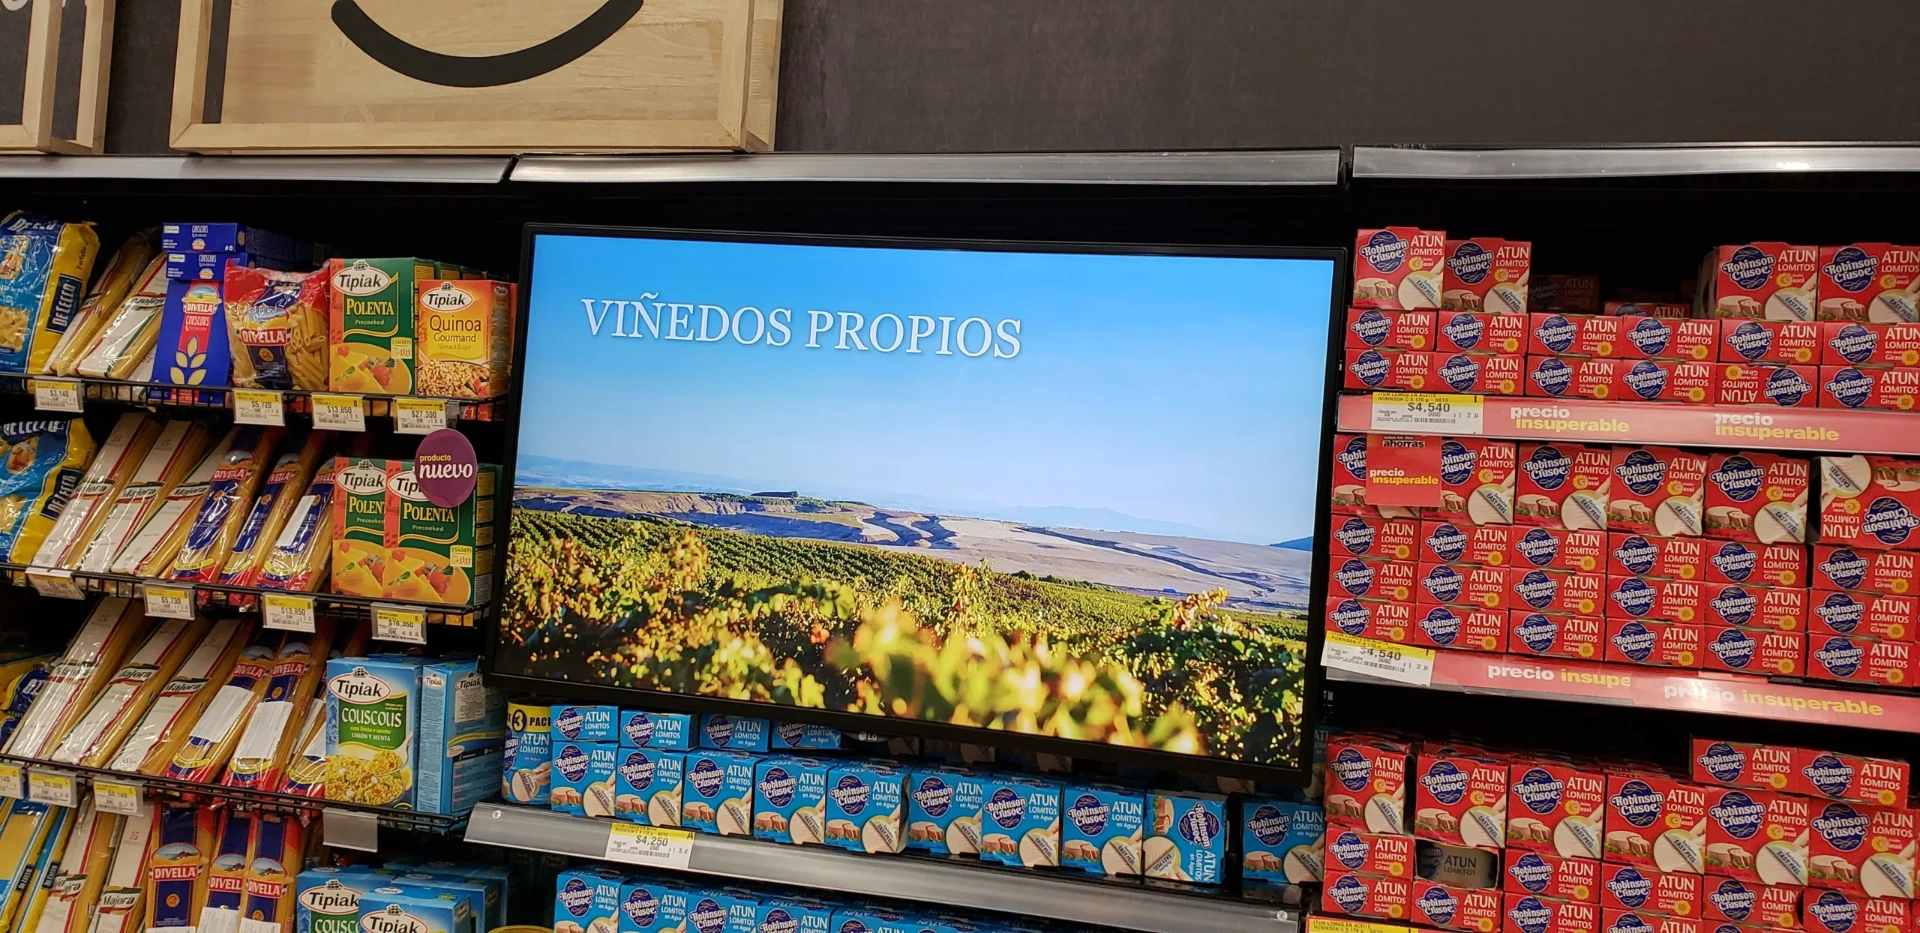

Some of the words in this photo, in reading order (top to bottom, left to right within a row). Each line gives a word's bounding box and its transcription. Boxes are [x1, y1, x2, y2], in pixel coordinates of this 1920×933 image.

[1361, 239, 1408, 255] Robinson
[1410, 235, 1444, 248] ATUN
[76, 246, 86, 269] Farfalle
[1369, 250, 1406, 265] Crusoe
[1410, 248, 1443, 256] LOMITOS
[1778, 250, 1816, 262] ATUN
[1723, 255, 1775, 273] Robinson
[1777, 264, 1815, 272] LOMITOS
[1732, 266, 1772, 281] Crusoe
[339, 274, 382, 291] Tipiak
[428, 294, 466, 306] Tipiak
[186, 303, 214, 313] DIVELLA
[346, 299, 394, 316] POLENTA
[186, 315, 210, 326] COUSCOUS
[430, 315, 481, 332] Quinoa
[581, 291, 792, 347] VIÑEDOS
[805, 309, 1022, 359] PROPIOS
[1351, 317, 1391, 331] Robinson
[1397, 313, 1430, 326] ATUN
[241, 329, 286, 344] DIVELLA
[1359, 326, 1390, 337] Crusoe
[1397, 326, 1428, 334] LOMITOS
[434, 333, 476, 342] Gourmand
[1532, 365, 1573, 381] Robinson
[1579, 362, 1613, 375] ATUN
[1539, 374, 1570, 387] Crusoe
[1579, 374, 1613, 384] LOMITOS
[1768, 377, 1801, 388] Crusoe
[1721, 389, 1758, 402] ATUN
[1765, 384, 1811, 396] Robinson
[1408, 402, 1450, 413] $4,540
[1510, 405, 1570, 420] precio
[1516, 418, 1630, 432] insuperable
[1716, 425, 1839, 440] insuperable
[419, 454, 451, 462] producto
[214, 469, 245, 479] DIVELLA
[419, 463, 473, 480] nuevo
[1370, 468, 1404, 477] precio
[1768, 462, 1807, 476] ATUN
[268, 472, 291, 482] IVELLA
[344, 473, 384, 489] Tipiak
[1373, 476, 1439, 485] insuperable
[1711, 467, 1765, 485] Robinson
[1768, 477, 1806, 486] LOMITOS
[1720, 478, 1762, 490] Crusoe
[349, 497, 385, 514] POLEN
[403, 503, 455, 523] POLENTA
[1866, 507, 1908, 522] Crusoe
[1381, 523, 1414, 535] ATUN
[1864, 516, 1919, 532] Robinson
[1335, 528, 1375, 541] Robinson
[1381, 535, 1413, 543] LOMITOS
[1343, 536, 1373, 547] Crusoe
[1359, 647, 1401, 660] $4,540
[272, 662, 303, 674] DIVELLA
[1488, 665, 1555, 681] precio
[427, 678, 442, 686] Tipiak
[460, 679, 481, 689] Tipiak
[337, 680, 383, 698] Tipiak
[1664, 683, 1736, 700] precio
[1742, 689, 1884, 716] insuperable
[342, 708, 402, 727] COUSCOUS
[515, 712, 525, 728] 3
[554, 716, 583, 727] Robinson
[585, 711, 610, 722] ATUN
[560, 722, 582, 732] Crusoe
[656, 720, 681, 731] ATUN
[521, 733, 550, 745] ATUN
[656, 731, 681, 739] LOMITOS
[1699, 752, 1746, 766] Robinson
[1752, 749, 1791, 764] ATUN
[1708, 762, 1742, 774] Crusoe
[1752, 763, 1791, 772] LOMITOS
[873, 781, 899, 794] ATUN
[914, 787, 953, 800] Robinson
[872, 794, 899, 802] LOMITOS
[921, 796, 950, 808] Crusoe
[1068, 805, 1109, 818] Robinson
[1112, 801, 1141, 815] ATUN
[1076, 814, 1106, 825] Crusoe
[1112, 815, 1140, 823] LOMITOS
[1195, 804, 1210, 847] Robinson
[1812, 815, 1870, 832] Robinson
[1872, 811, 1913, 828] ATUN
[1188, 811, 1201, 844] Crusoe
[1822, 827, 1866, 838] Crusoe
[1872, 826, 1913, 838] LOMITOS
[636, 835, 668, 846] $4,250
[1195, 850, 1203, 880] LOMITOS
[1204, 850, 1216, 882] ATUN
[1444, 855, 1476, 868] ATUN
[154, 866, 195, 879] DIVELLA
[1444, 866, 1476, 875] LOMITOS
[210, 876, 242, 890] DIVELL
[249, 880, 281, 896] DIVELLA
[309, 892, 358, 909] Tipiak
[315, 919, 359, 933] COUSC
[370, 916, 419, 933] Tipiak
